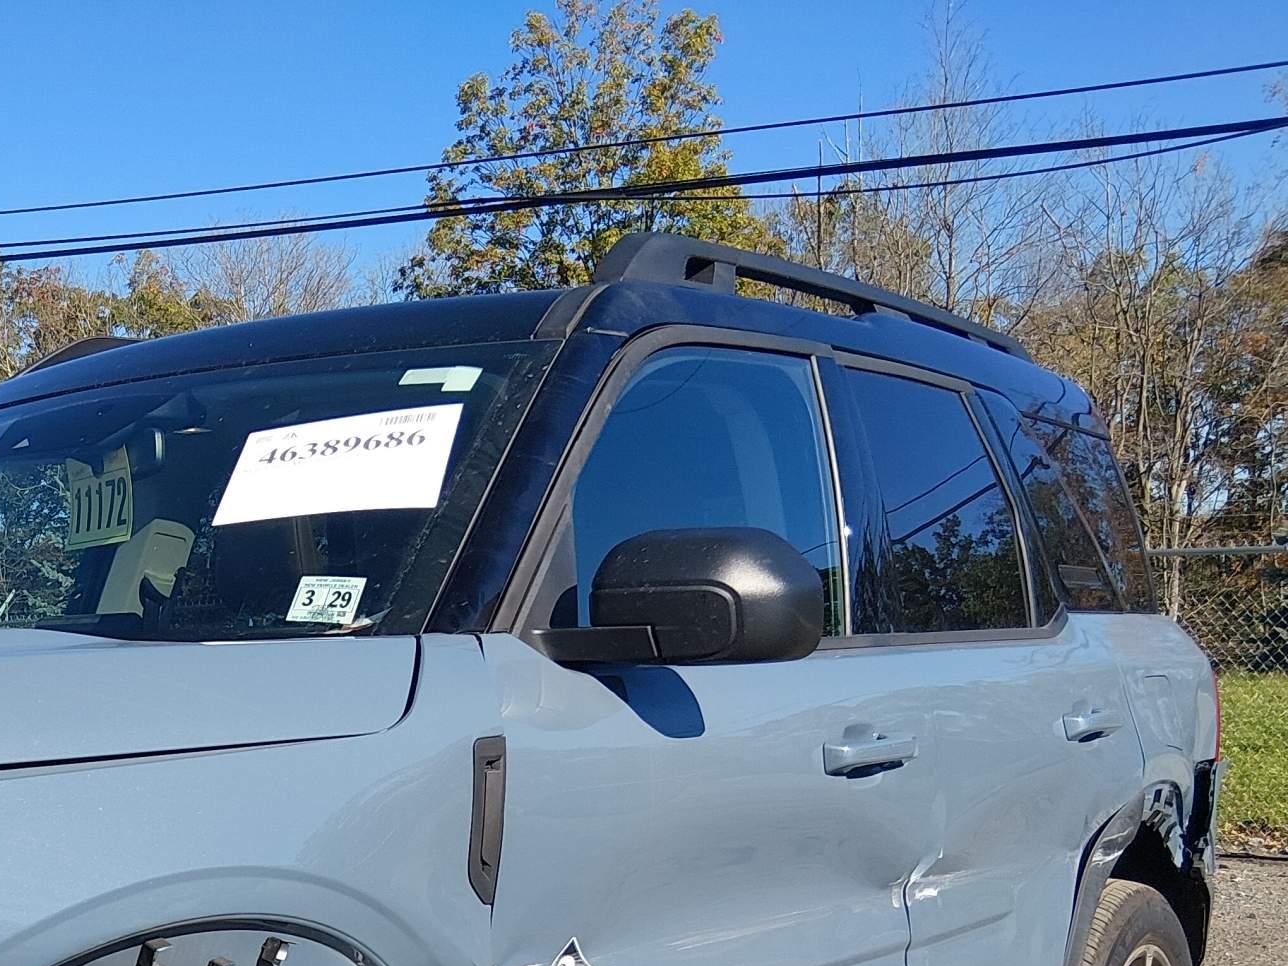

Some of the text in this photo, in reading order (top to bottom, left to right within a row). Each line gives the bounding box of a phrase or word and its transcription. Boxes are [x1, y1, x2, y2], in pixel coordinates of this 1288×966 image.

[258, 429, 427, 465] 46389686
[74, 476, 128, 535] 11172
[301, 589, 353, 609] 3 29
